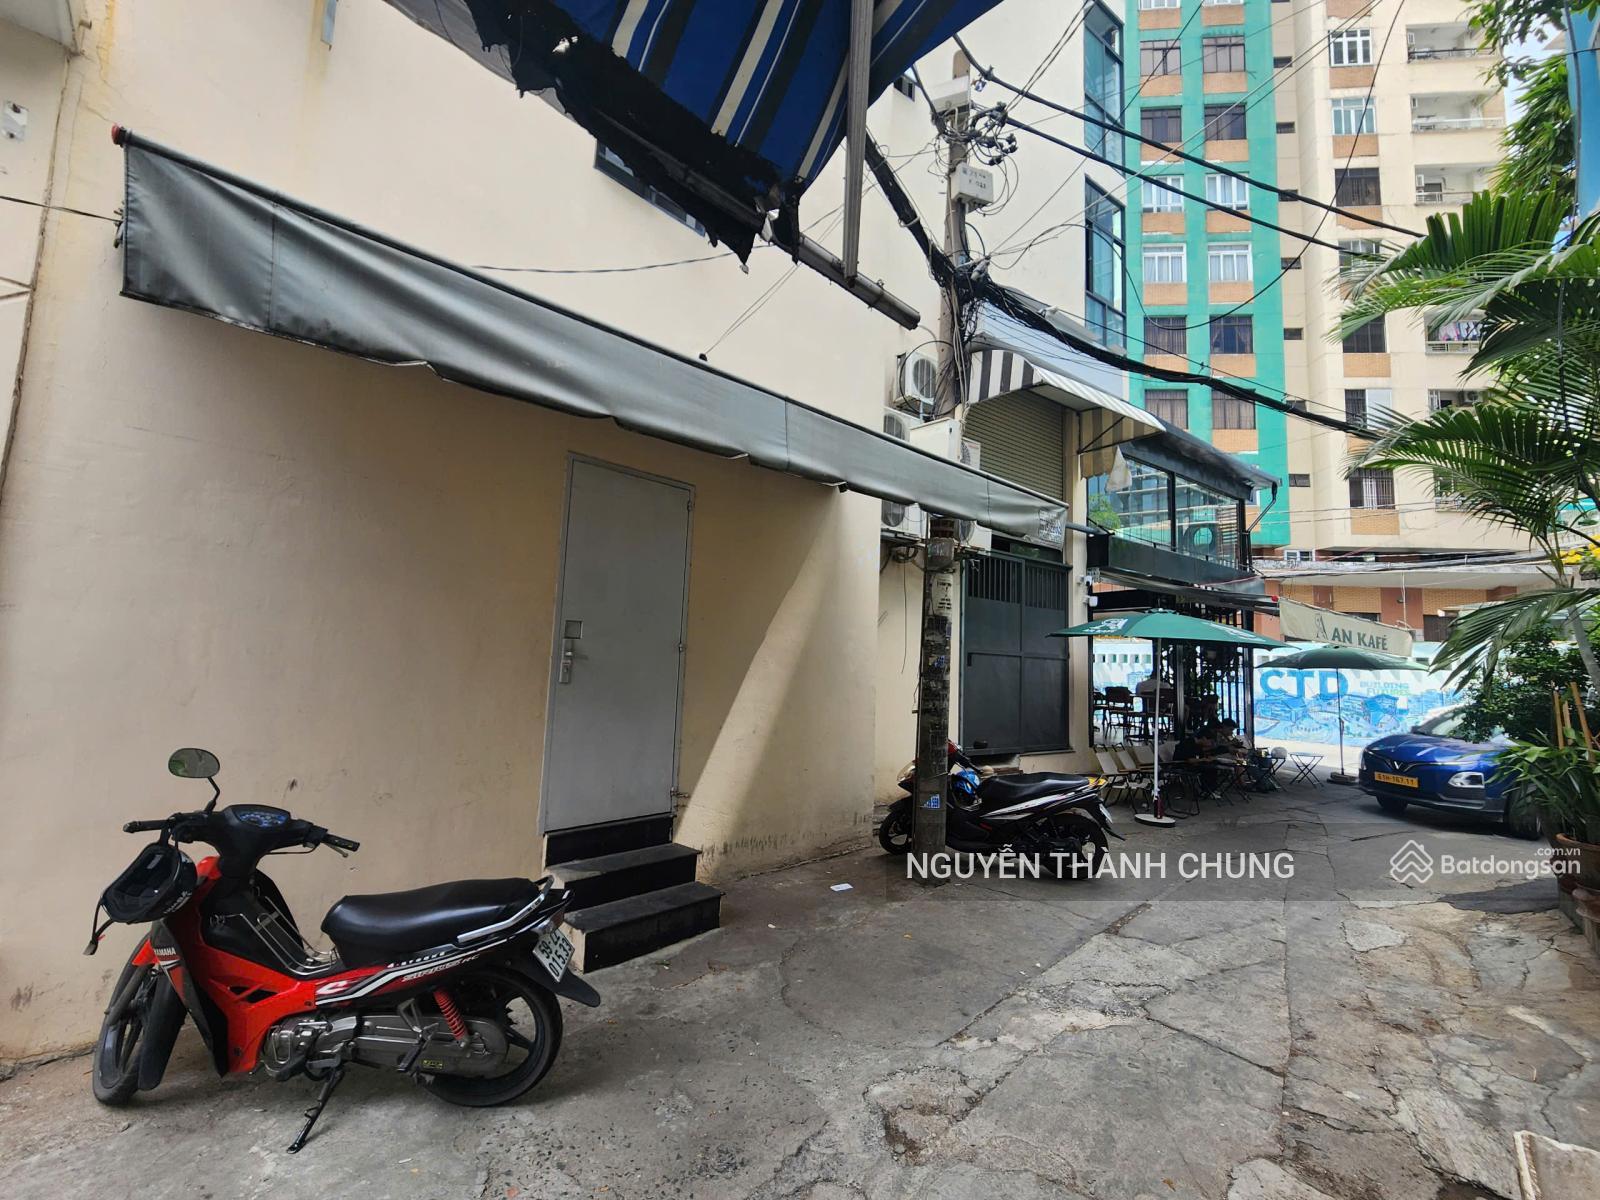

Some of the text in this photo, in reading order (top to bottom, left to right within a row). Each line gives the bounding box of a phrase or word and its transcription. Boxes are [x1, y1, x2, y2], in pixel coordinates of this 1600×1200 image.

[1331, 627, 1353, 644] AN
[1357, 632, 1388, 650] KAFÉ
[1260, 670, 1349, 698] CTD
[153, 946, 177, 956] YAMAHA
[548, 938, 572, 977] 015.33
